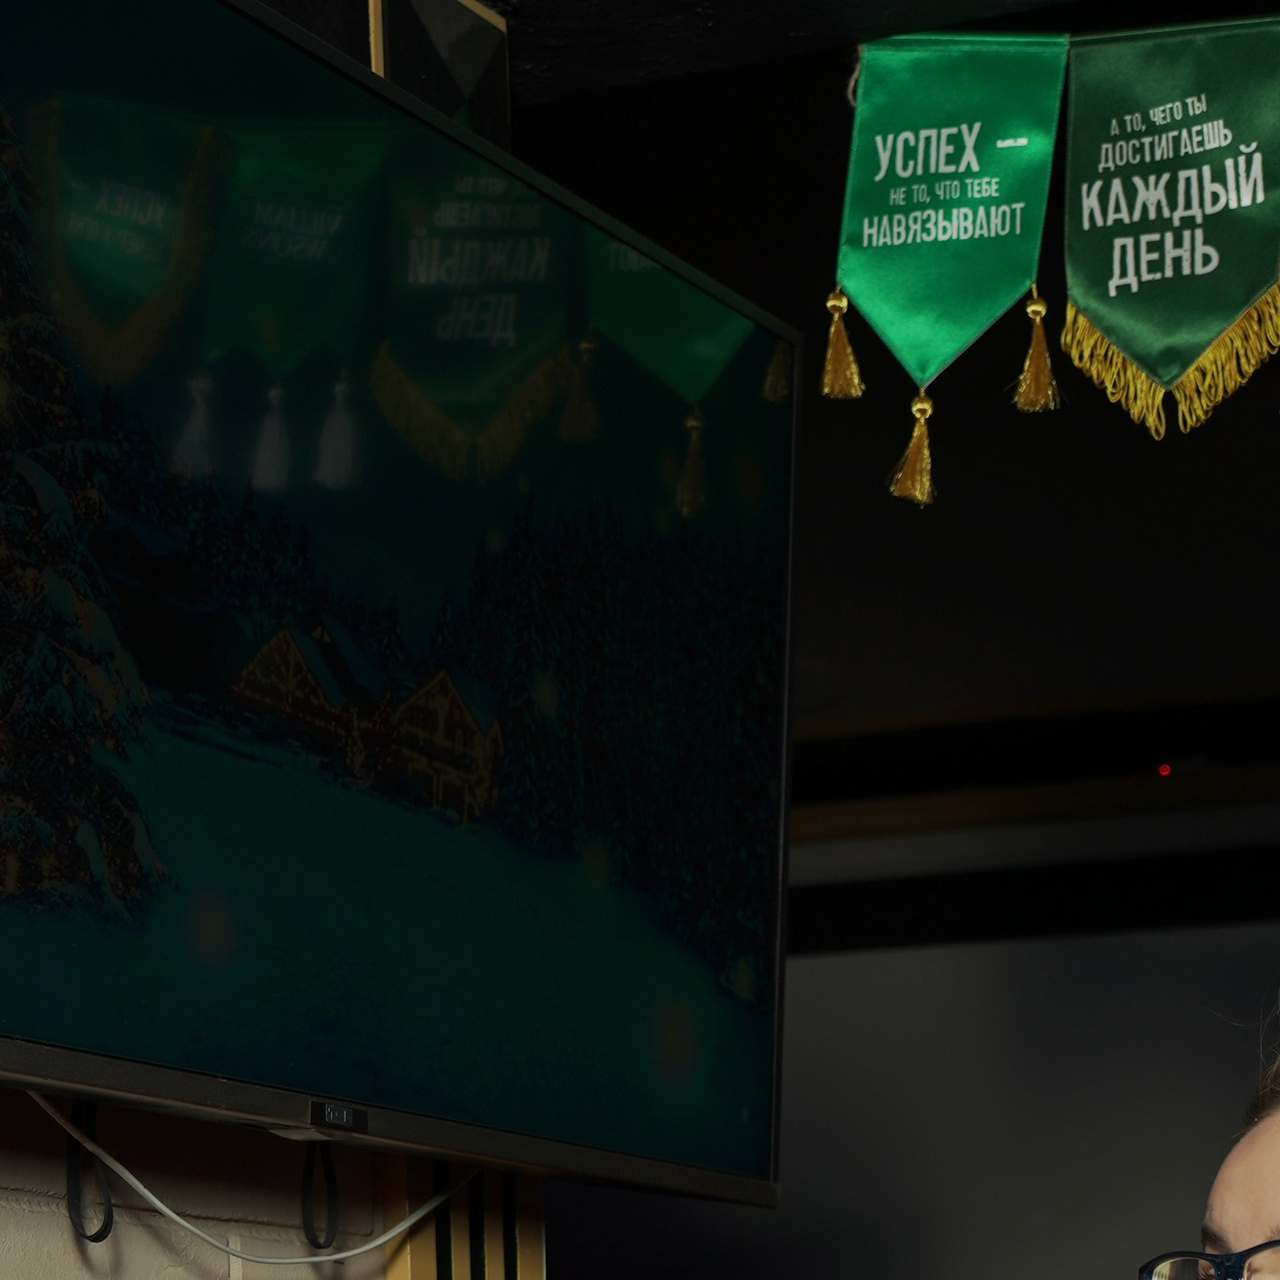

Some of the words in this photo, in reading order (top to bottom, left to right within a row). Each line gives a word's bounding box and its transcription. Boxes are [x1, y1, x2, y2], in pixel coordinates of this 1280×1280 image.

[1110, 118, 1120, 137] А
[1123, 112, 1146, 133] ТО,
[1149, 101, 1183, 126] ЧЕГО
[1185, 93, 1207, 117] ТЫ
[873, 120, 983, 183] УСПЕХ
[1097, 119, 1233, 173] ДОСТИГАЕШЬ
[889, 187, 907, 206] НЕ
[911, 183, 931, 204] ТО,
[934, 179, 961, 201] ЧТО
[964, 177, 1000, 199] ТЕБЕ
[1081, 141, 1265, 231] КАЖДЫЙ
[862, 202, 1026, 248] НАВЯЗЫВАЮТ
[1108, 227, 1220, 297] ДЕНЬ
